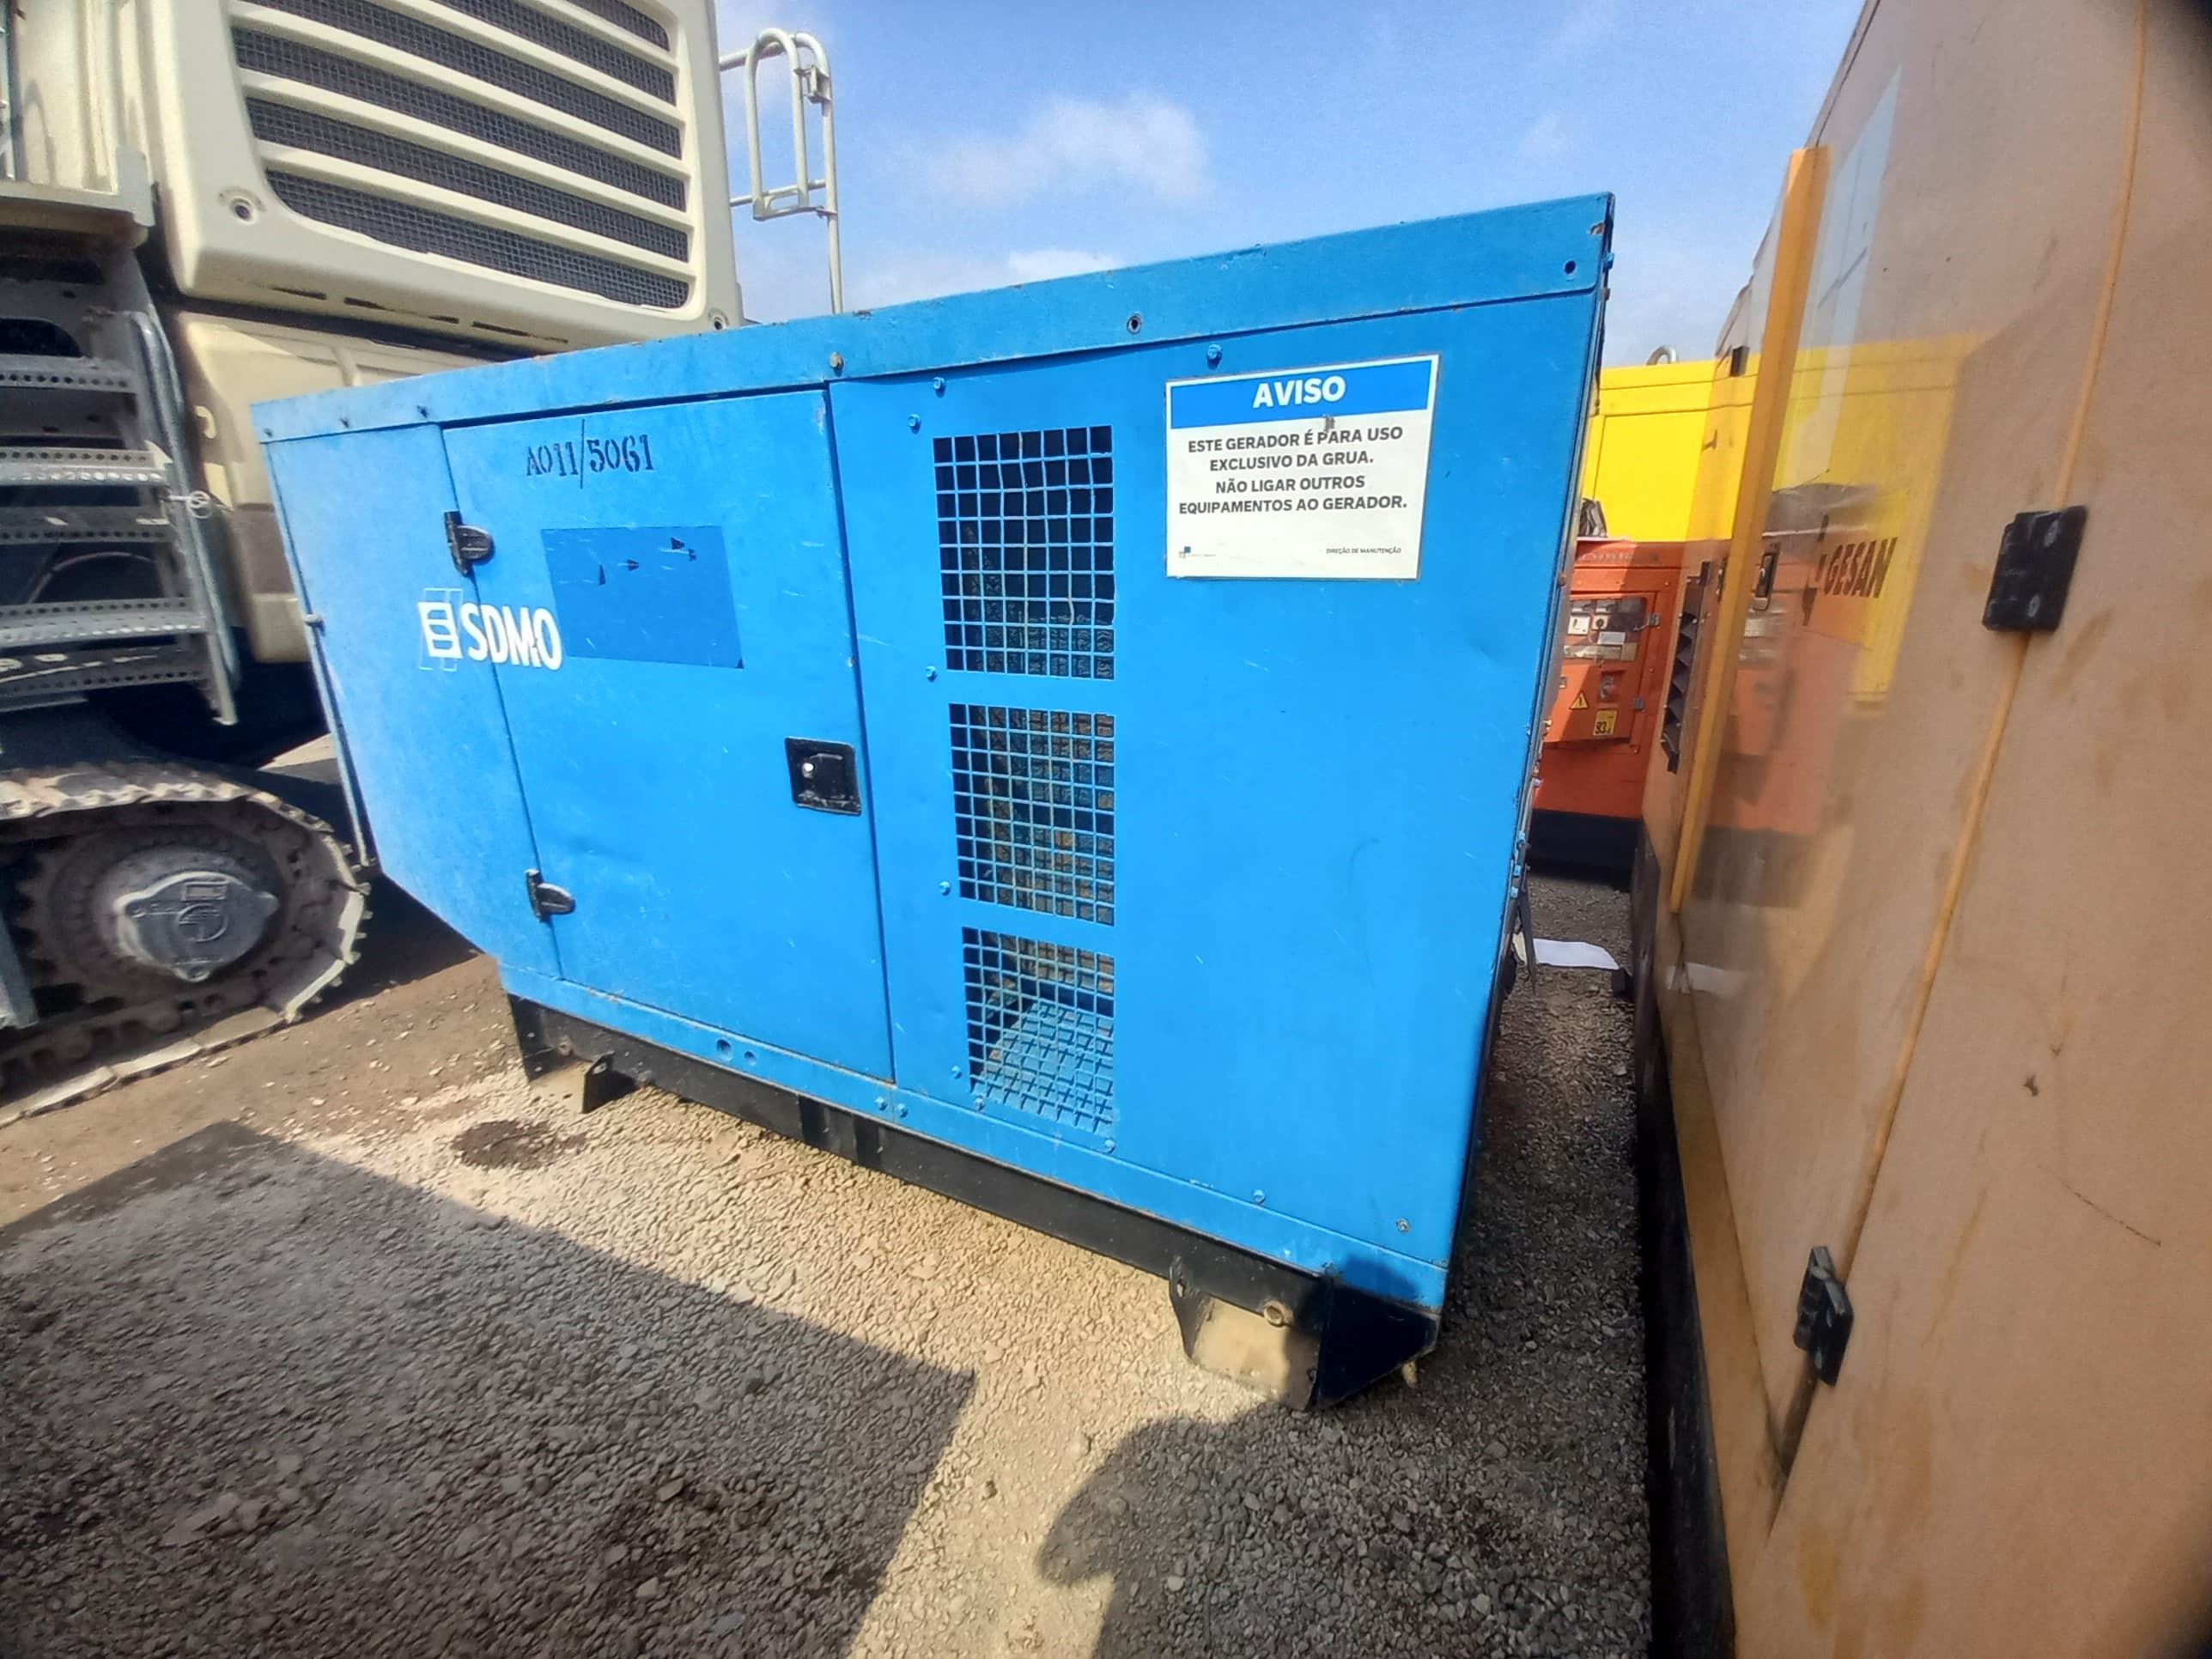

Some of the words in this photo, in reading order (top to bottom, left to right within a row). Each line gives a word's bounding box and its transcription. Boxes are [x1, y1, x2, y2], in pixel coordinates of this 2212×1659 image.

[1253, 376, 1346, 409] AVISO
[1188, 439, 1223, 453] ESTE
[1226, 433, 1299, 450] GERADOR
[1304, 428, 1314, 445] É
[1317, 429, 1363, 444] PARA
[1367, 426, 1403, 441] USO
[1210, 455, 1292, 471] EXCLUSIVO
[1297, 453, 1318, 467] DA
[1322, 451, 1374, 465] GRUA.
[1216, 478, 1248, 494] NÃO
[1251, 478, 1296, 492] LIGAR
[1299, 476, 1365, 490] OUTROS
[1179, 500, 1292, 514] EQUIPAMENTOS
[1296, 498, 1319, 511] AO
[1322, 495, 1407, 510] GERADOR.
[1360, 546, 1401, 555] MANUTENÇÃO
[1824, 537, 1898, 599] GESAN
[460, 602, 563, 671] SDMO
